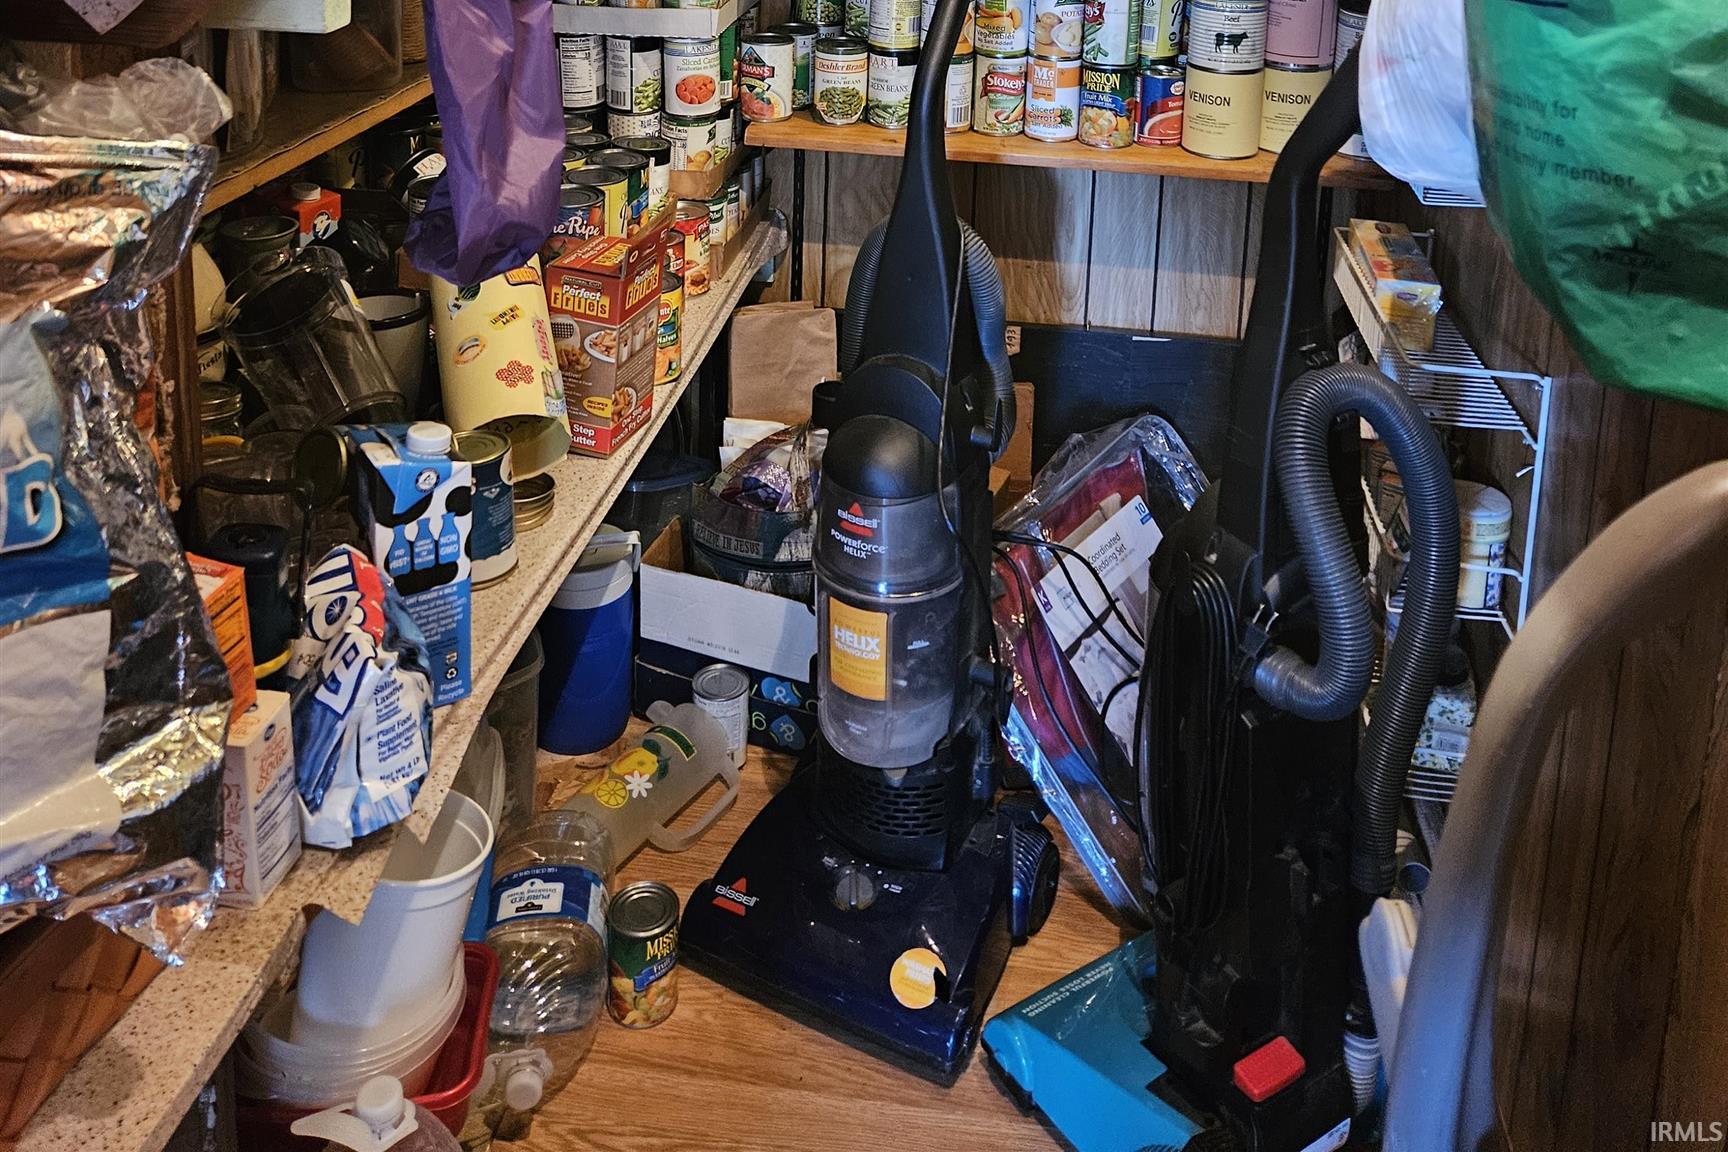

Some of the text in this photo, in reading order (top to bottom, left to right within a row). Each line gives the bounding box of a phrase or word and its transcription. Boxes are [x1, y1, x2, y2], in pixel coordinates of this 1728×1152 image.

[1224, 15, 1242, 23] Beef
[983, 23, 1006, 32] Mixed
[977, 30, 1015, 40] Vegetables
[681, 58, 702, 66] Sliced
[818, 61, 866, 72] Deshler Brand
[1083, 69, 1121, 91] MISSION
[886, 84, 909, 92] BEANS
[1086, 82, 1113, 93] PRIDE
[1099, 94, 1113, 103] Mix
[1189, 89, 1231, 107] VENISON
[1265, 90, 1312, 105] VENISON
[1031, 104, 1055, 114] Sliced
[1551, 100, 1579, 120] for
[1029, 112, 1057, 123] Carrots
[568, 215, 601, 240] Ripe
[562, 284, 602, 301] Perfect
[552, 291, 608, 315] Fries
[656, 333, 677, 345] Halves
[587, 399, 608, 407] RECIPES
[573, 423, 595, 437] Step
[1135, 502, 1147, 516] 10
[440, 533, 457, 546] NON
[722, 535, 761, 555] IN JESUS
[439, 543, 459, 556] GMO
[1087, 532, 1121, 565] Coordinated
[1116, 544, 1127, 556] Set
[834, 624, 880, 648] HELIX
[834, 641, 881, 660] TECHNOLOGY
[373, 677, 398, 696] Saline
[376, 723, 396, 740] Plant
[396, 711, 413, 730] Food
[377, 719, 418, 750] Supplement
